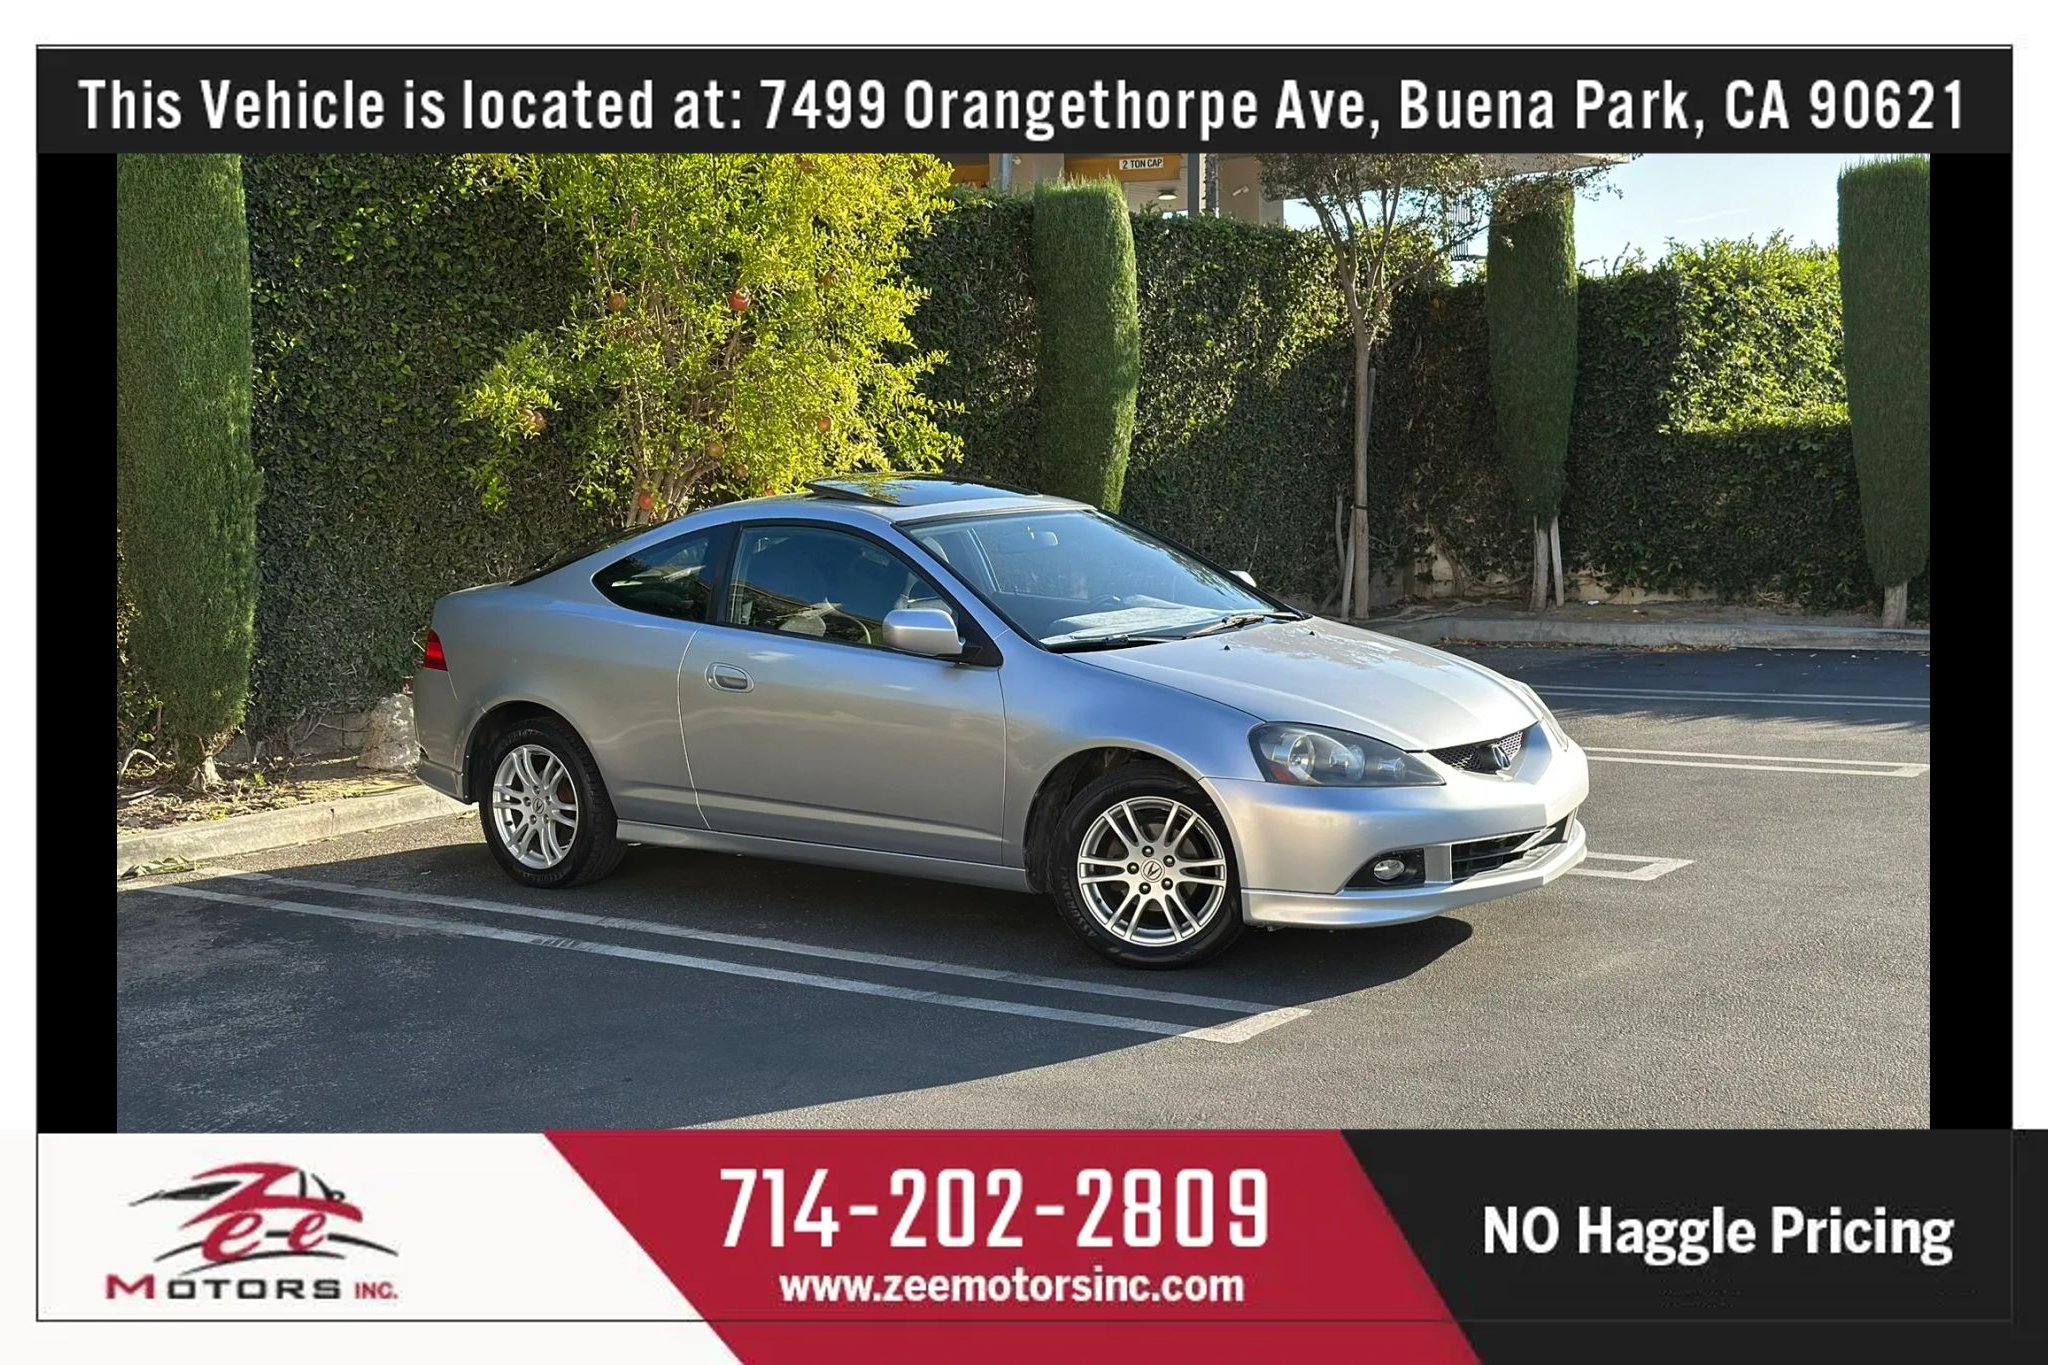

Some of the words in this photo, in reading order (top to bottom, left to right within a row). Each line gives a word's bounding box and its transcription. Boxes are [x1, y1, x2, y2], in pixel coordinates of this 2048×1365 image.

[1122, 160, 1128, 169] 2
[1130, 160, 1146, 168] TON
[1147, 158, 1163, 168] CAP
